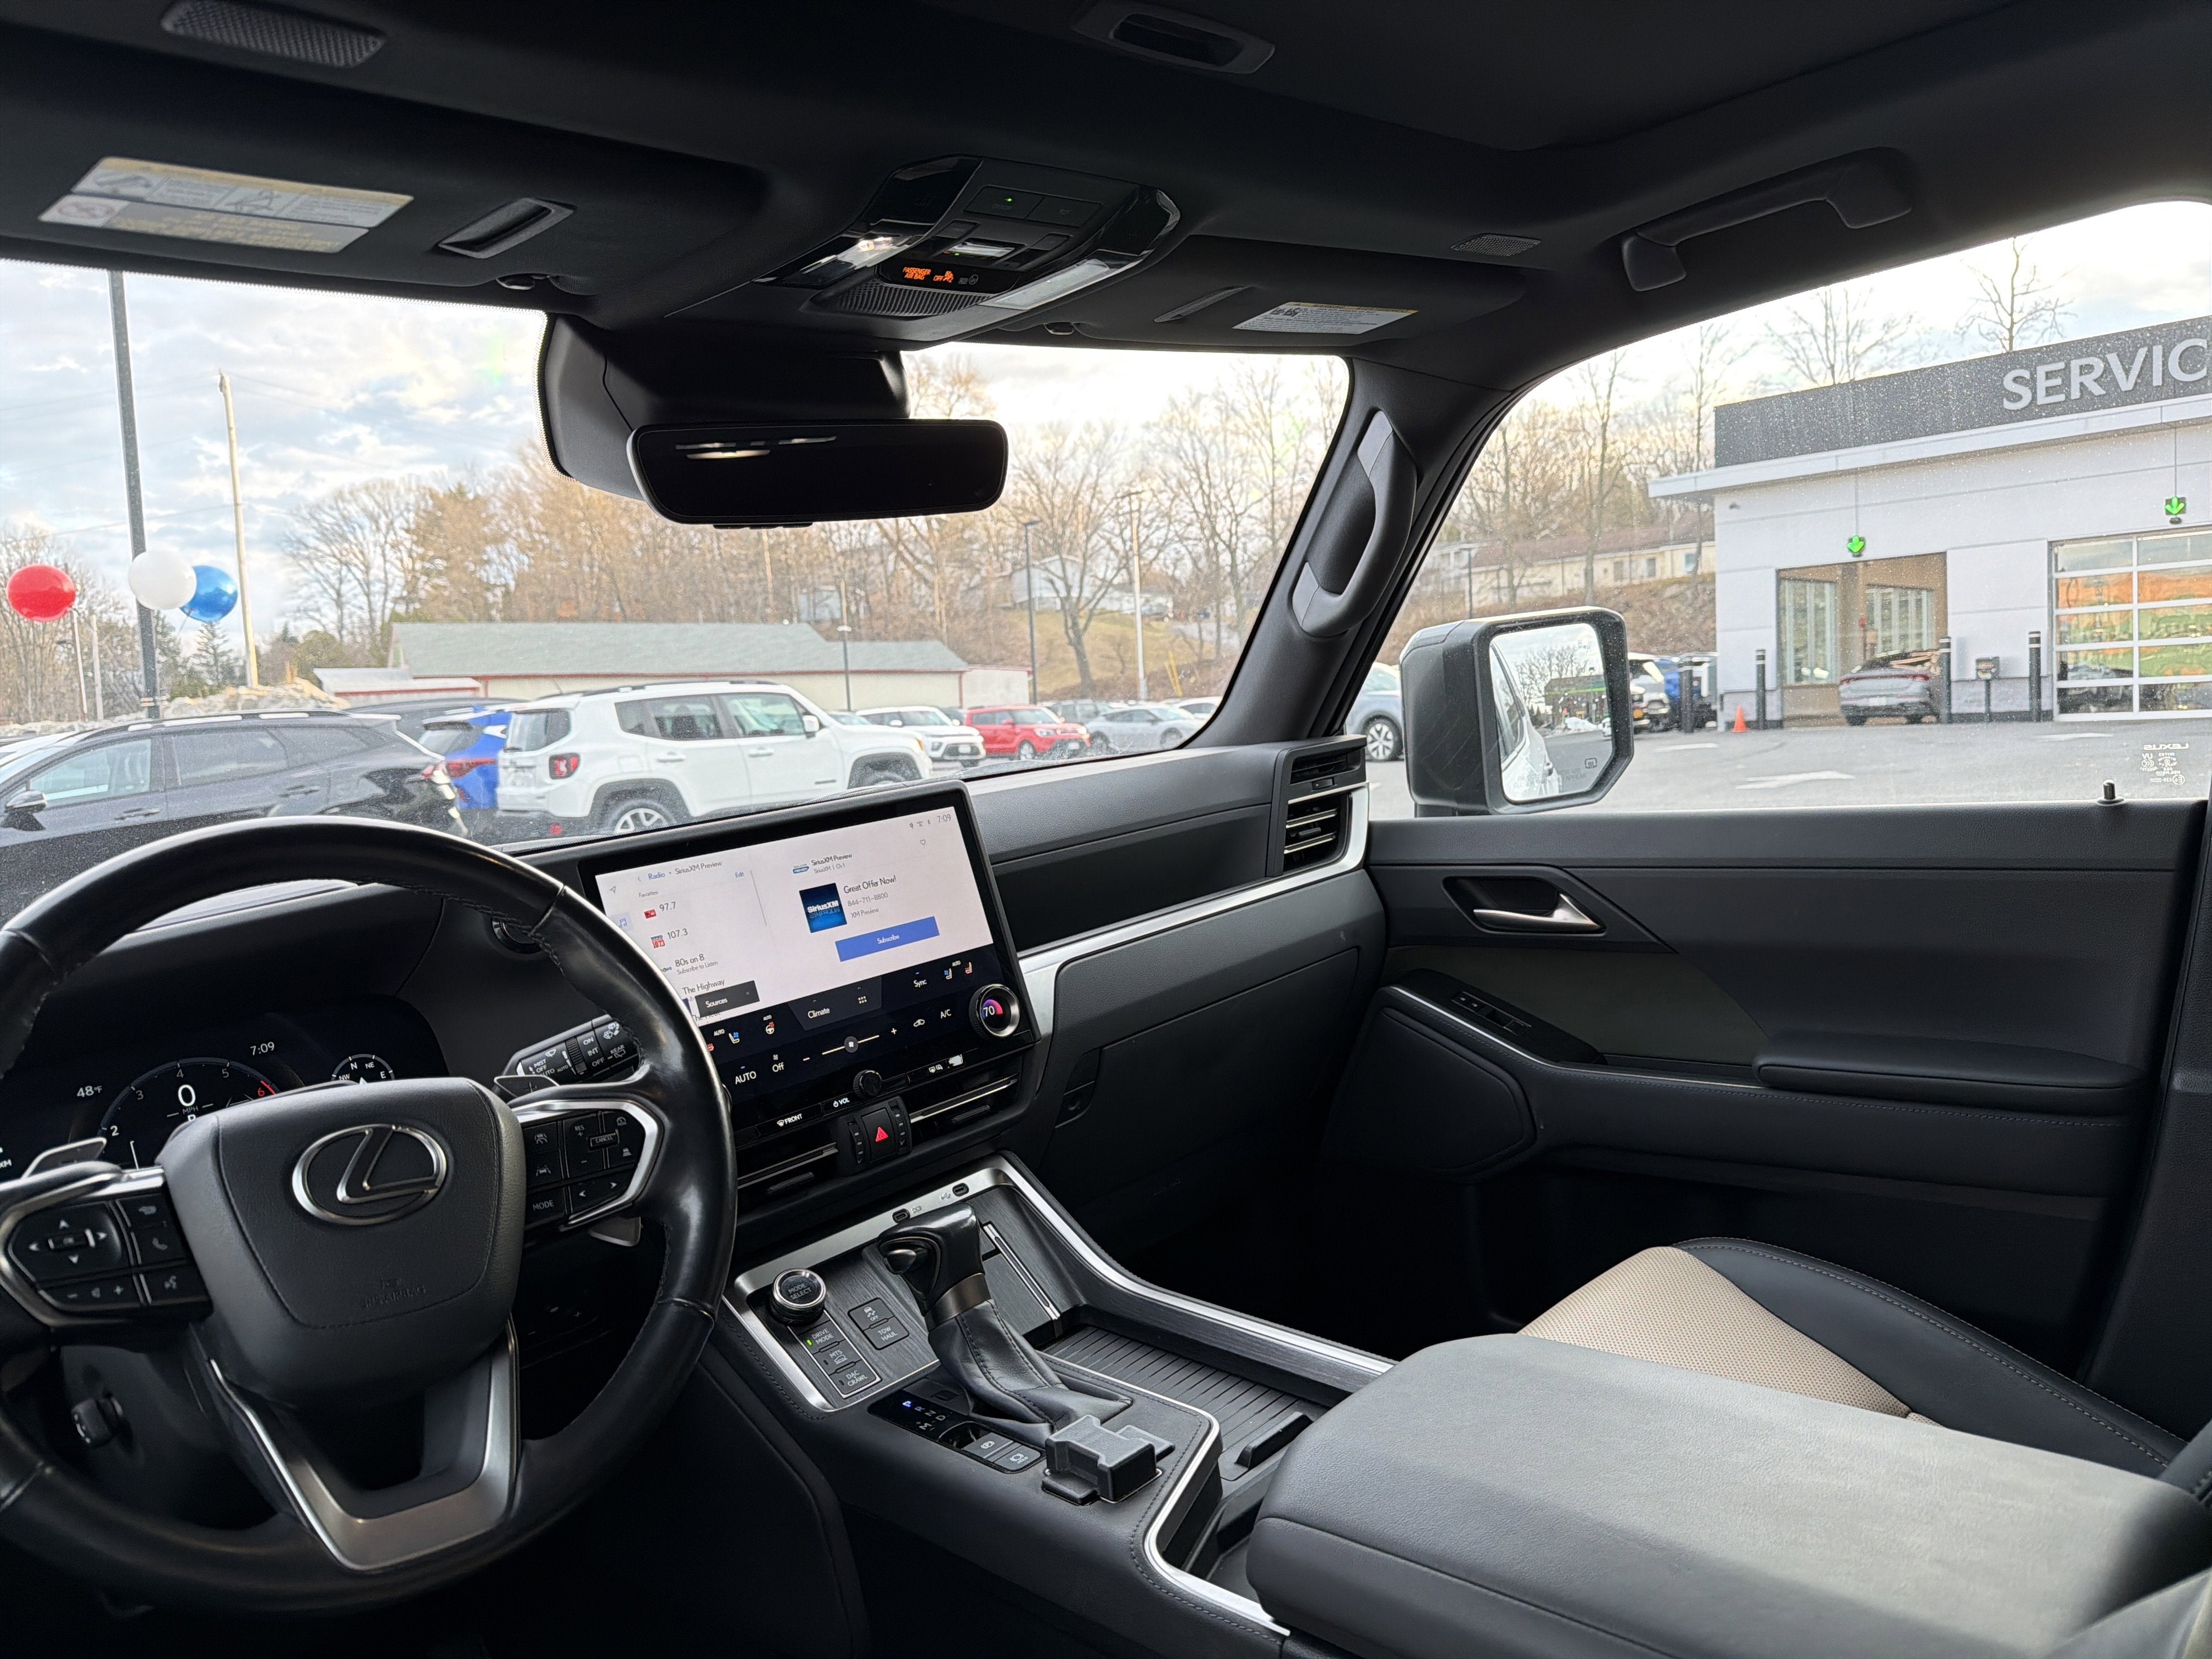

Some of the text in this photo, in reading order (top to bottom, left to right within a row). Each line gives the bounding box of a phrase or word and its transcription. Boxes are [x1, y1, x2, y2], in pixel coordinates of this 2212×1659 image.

[902, 267, 932, 275] PASSENGER
[2002, 338, 2208, 410] SERVIC
[937, 813, 951, 823] 7:09
[811, 853, 853, 866] SiriusXM Preview
[648, 861, 722, 881] Radio SiriusXM Preview
[843, 874, 896, 894] Great Offer Now!
[639, 889, 658, 898] Favorites
[848, 892, 888, 907] 844-711-8800
[659, 901, 676, 912] 97.7
[807, 900, 839, 913] SiriusXM
[860, 907, 879, 917] Preview
[667, 928, 688, 940] 107.3
[877, 934, 900, 944] Subscribe
[675, 957, 689, 967] 80s
[699, 953, 705, 962] 8
[677, 966, 699, 975] Subscribe
[704, 961, 718, 969] Listen
[682, 979, 725, 995] The Highway
[913, 978, 927, 988] Sync
[705, 998, 728, 1008] Sources
[808, 1007, 830, 1019] Climate
[940, 1008, 952, 1019] A/C
[983, 1005, 995, 1017] 70
[714, 1028, 725, 1036] AUTO
[583, 1037, 594, 1045] ON
[250, 1041, 275, 1056] 7:09
[587, 1047, 599, 1057] INT
[610, 1045, 625, 1054] REAR
[533, 1058, 546, 1068] MIST
[591, 1057, 605, 1067] OFF
[772, 1062, 785, 1073] Off
[176, 1069, 184, 1079] 4
[222, 1069, 229, 1078] 5
[536, 1064, 548, 1073] OFF
[735, 1071, 757, 1085] AUTO
[136, 1090, 144, 1100] 3
[178, 1084, 196, 1107] 0
[257, 1087, 265, 1097] 6
[182, 1105, 199, 1115] MPH
[784, 1113, 803, 1125] FRONT
[110, 1125, 119, 1137] 2
[532, 1199, 554, 1210] MODE
[787, 1283, 807, 1294] MODE
[789, 1288, 812, 1300] SELECT
[811, 1328, 830, 1340] DRIVE
[877, 1325, 891, 1335] TOW
[815, 1333, 834, 1345] MODE
[881, 1331, 898, 1341] HAUL
[829, 1349, 843, 1359] MTS
[845, 1369, 860, 1380] DAC
[847, 1374, 868, 1387] CRAWL
